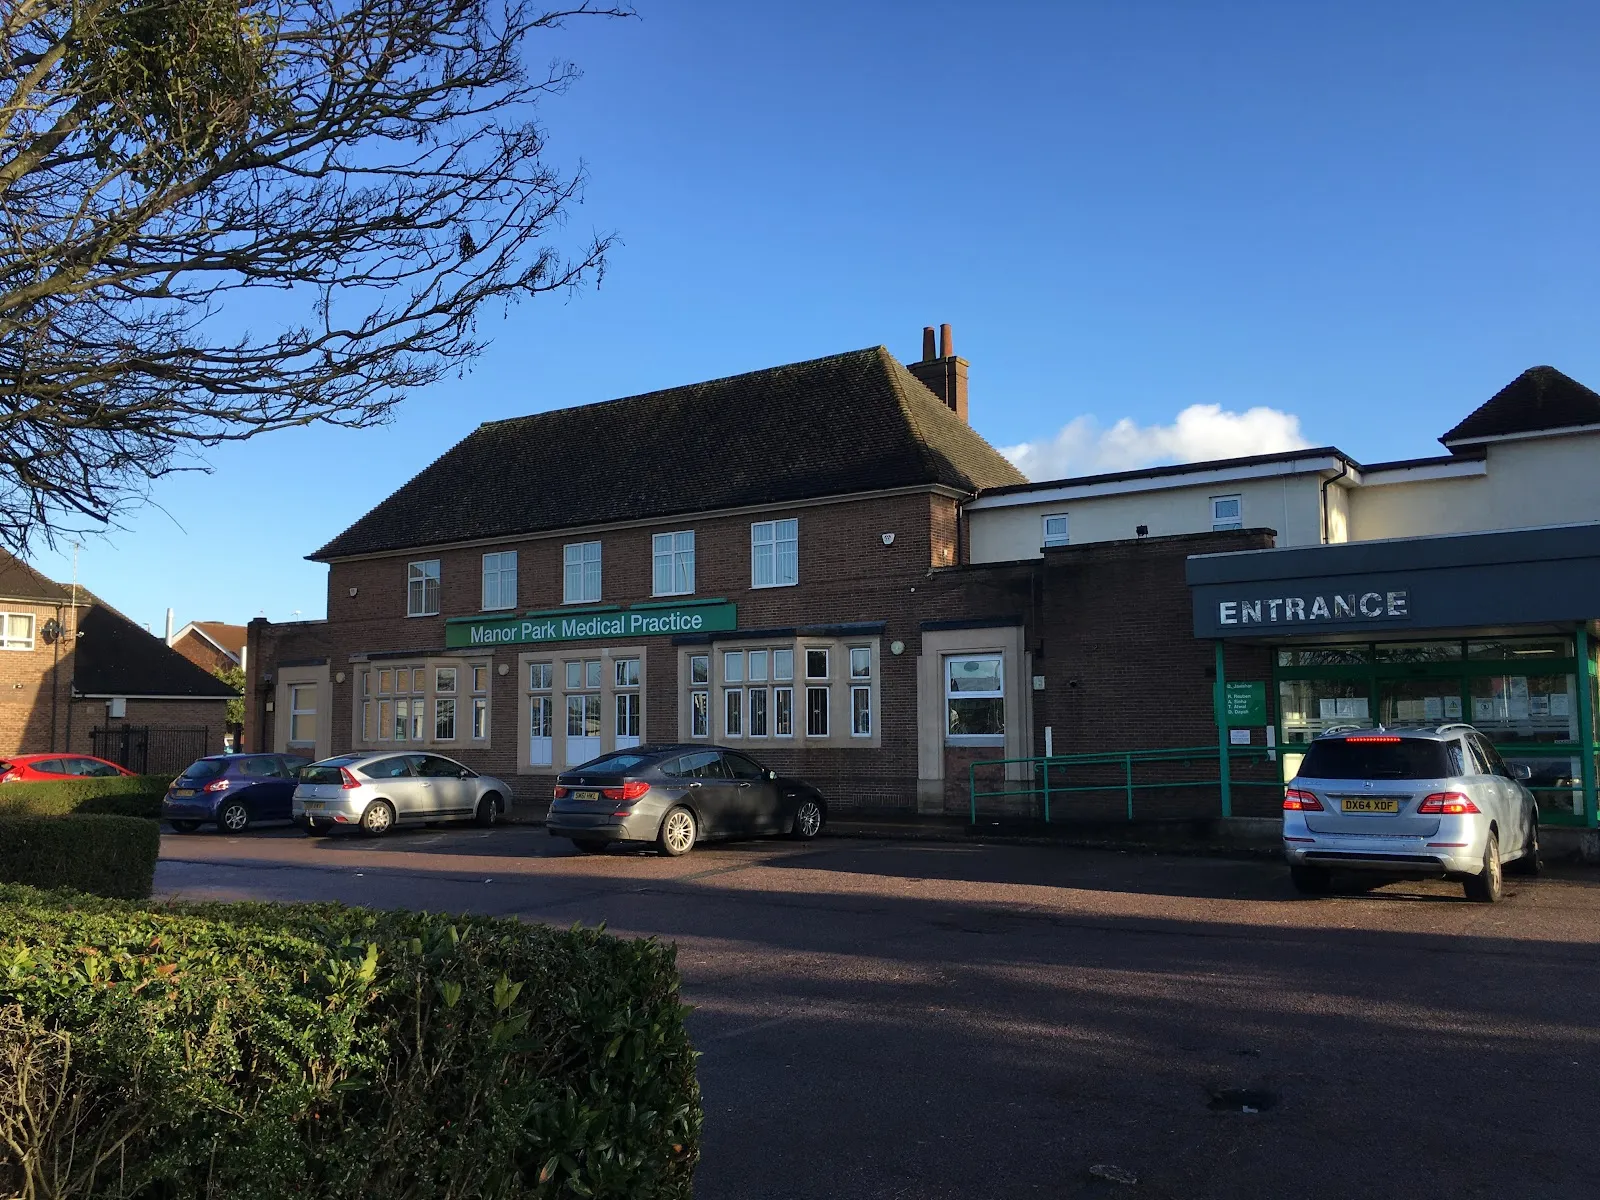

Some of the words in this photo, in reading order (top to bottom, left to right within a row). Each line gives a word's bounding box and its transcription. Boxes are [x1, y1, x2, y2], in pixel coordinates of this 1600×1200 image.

[1219, 590, 1408, 625] ENTRANCE
[470, 626, 517, 643] Manor
[521, 622, 556, 640] Park
[562, 615, 625, 637] Medical
[630, 611, 702, 633] Practice
[1345, 800, 1371, 810] DX64
[1374, 801, 1394, 810] XDF
